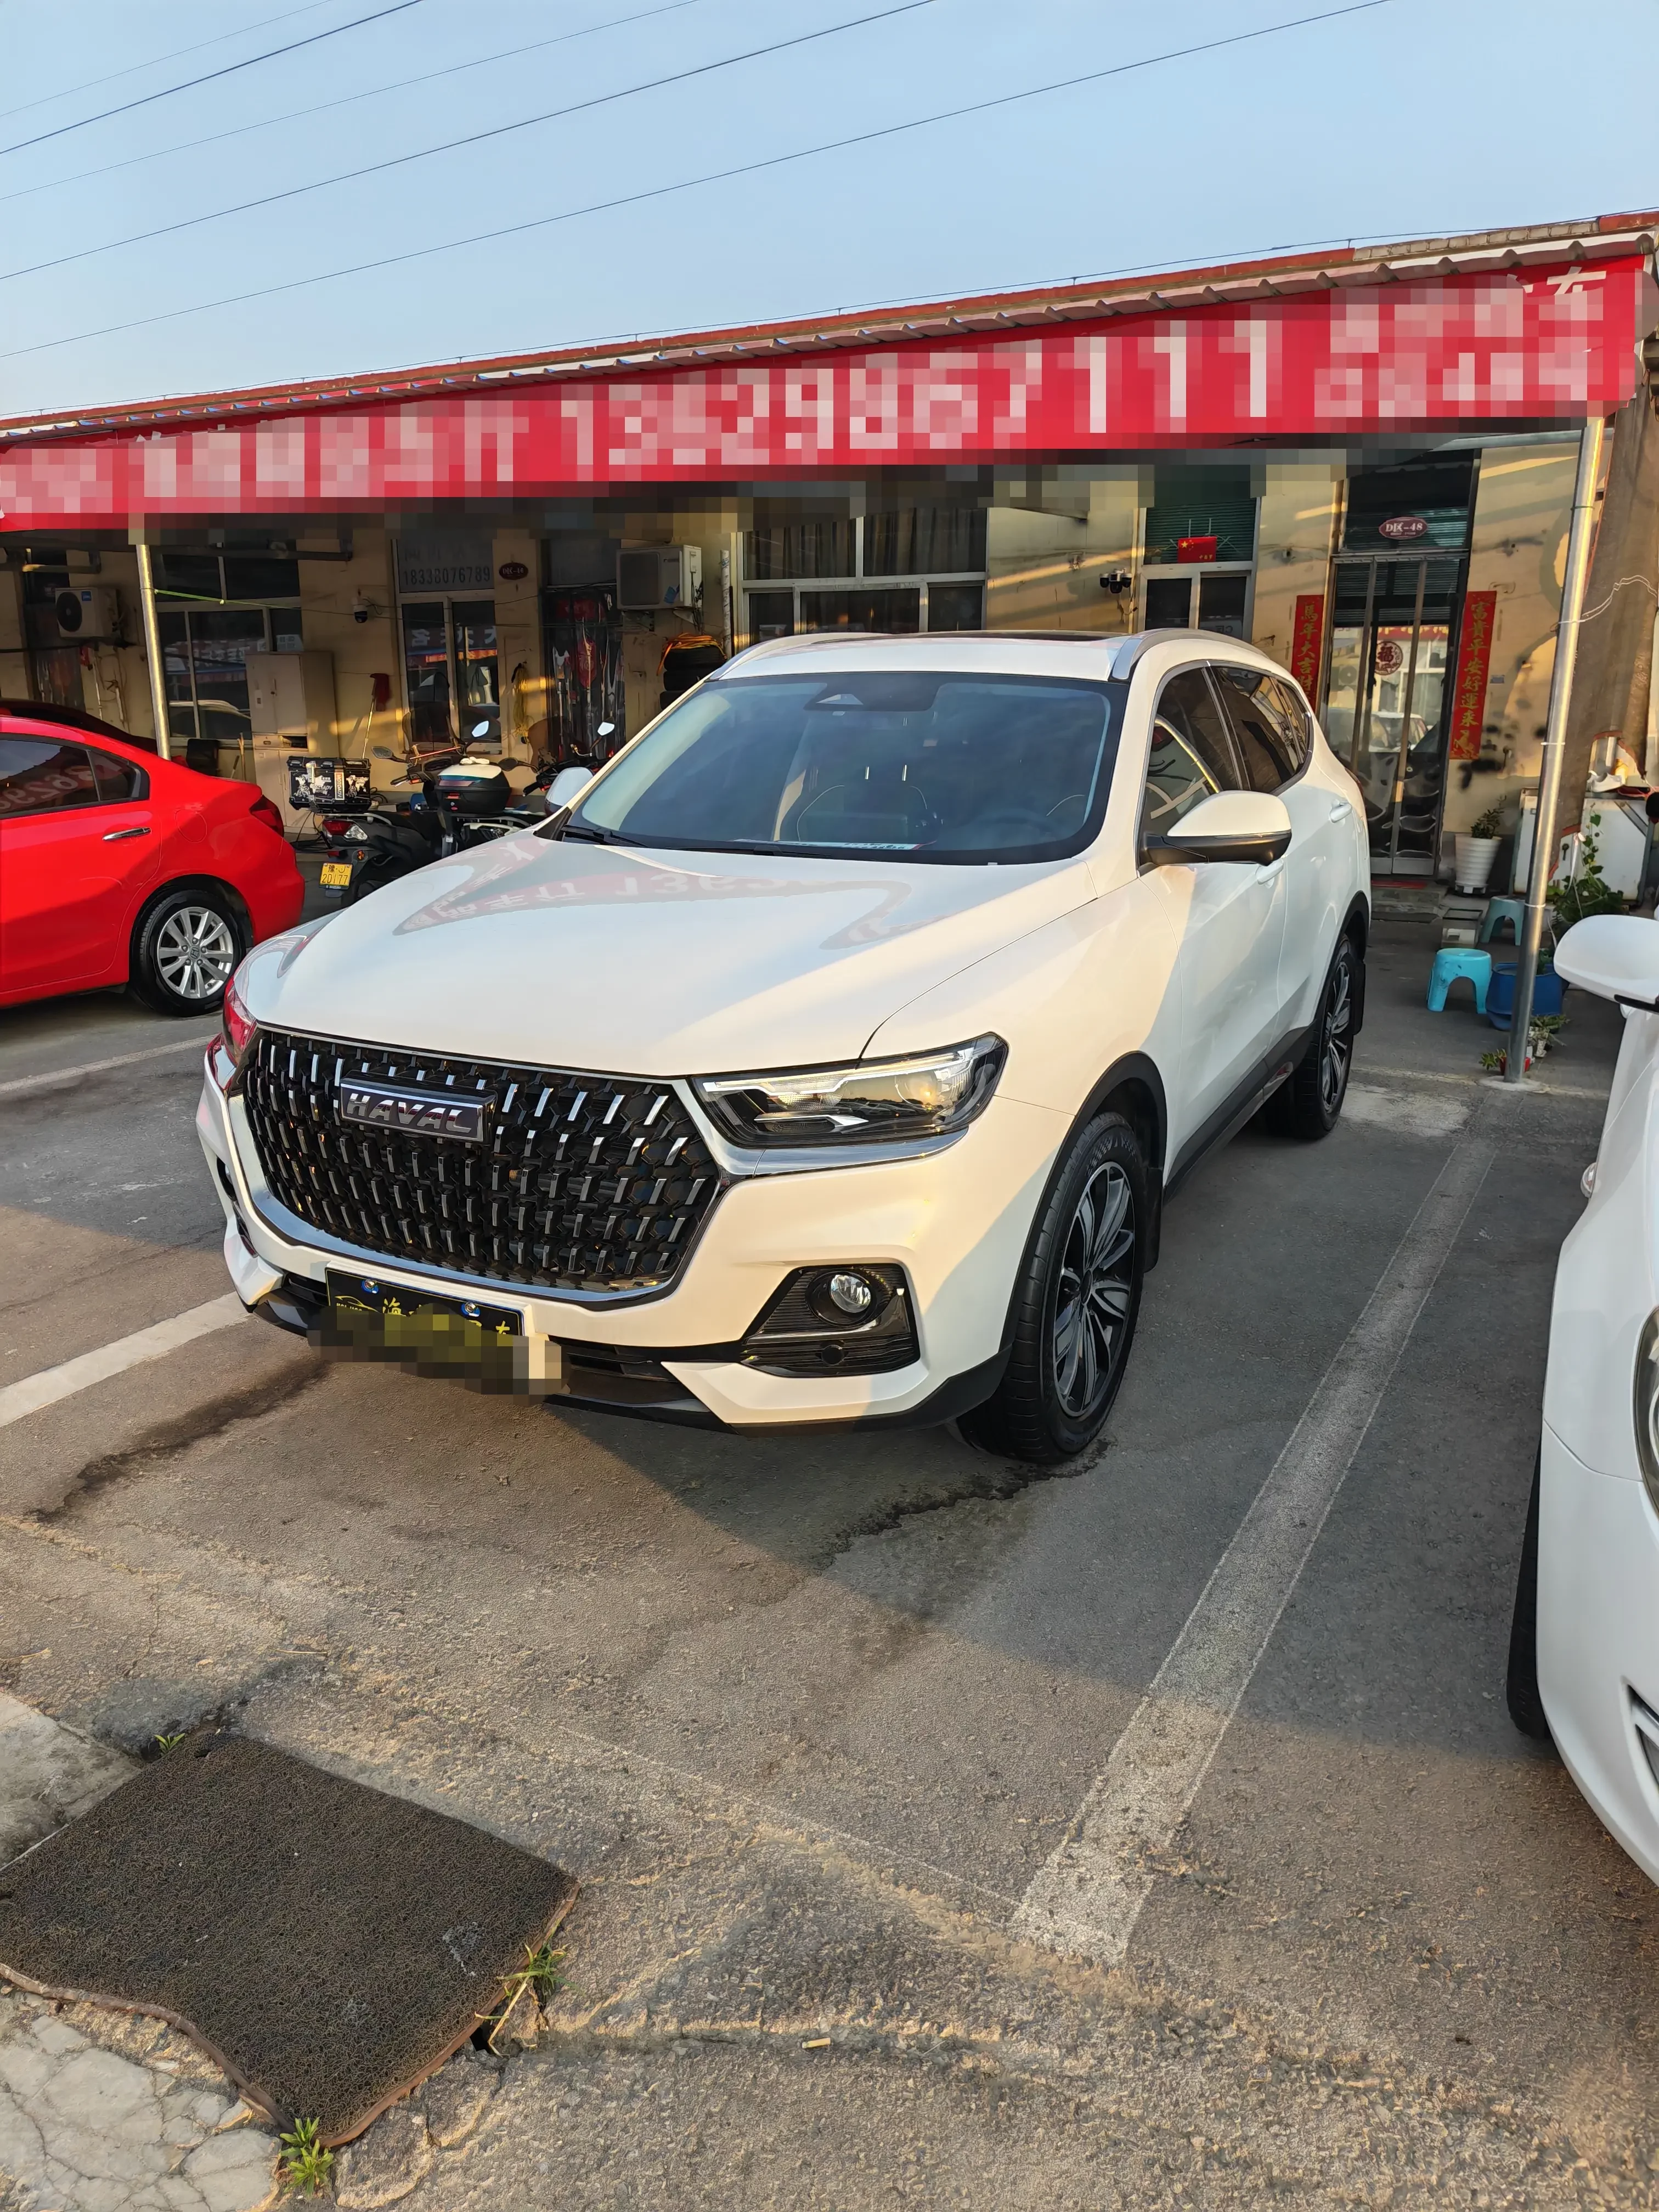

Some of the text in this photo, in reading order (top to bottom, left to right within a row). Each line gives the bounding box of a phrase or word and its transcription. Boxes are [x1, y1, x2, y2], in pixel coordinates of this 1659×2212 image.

[1385, 522, 1423, 532] D区-48
[1377, 646, 1394, 663] 福
[346, 1093, 472, 1133] HAVAL
